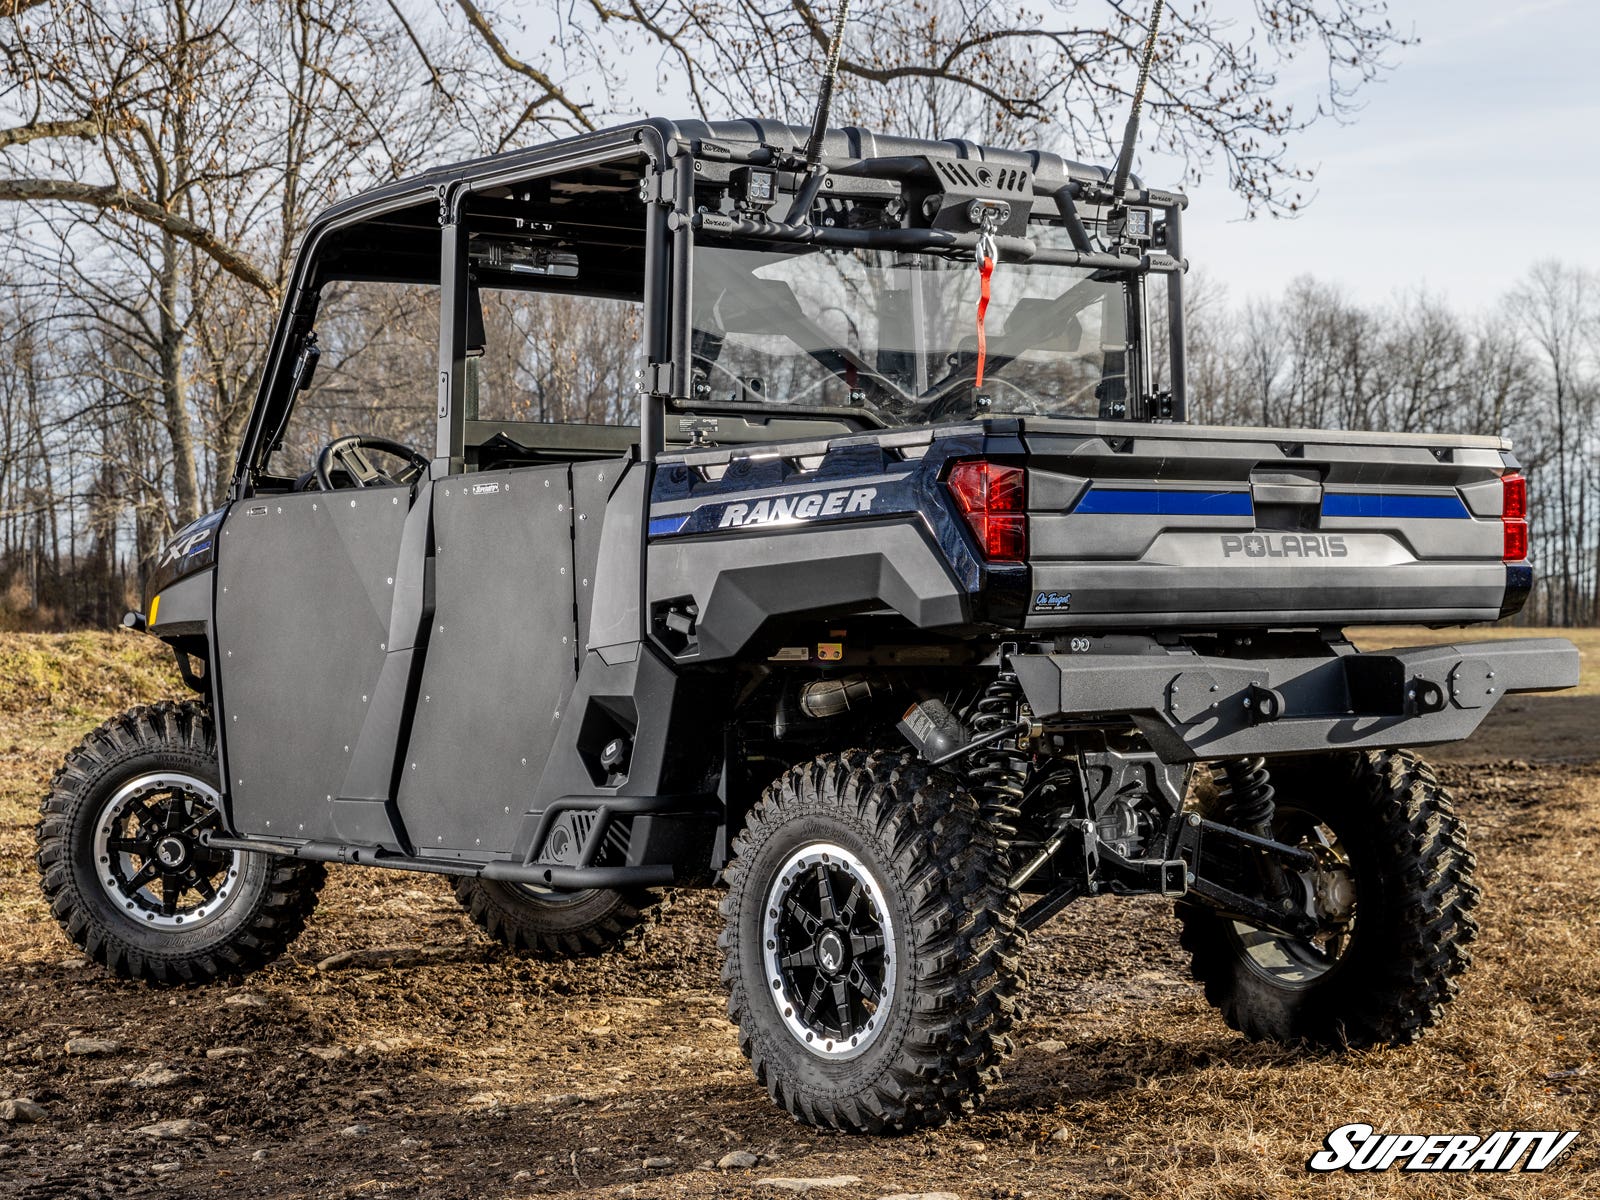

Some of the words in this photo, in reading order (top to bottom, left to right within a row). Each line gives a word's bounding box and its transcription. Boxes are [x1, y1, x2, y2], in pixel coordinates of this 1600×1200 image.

[718, 487, 877, 528] RANGER
[160, 529, 210, 569] XP
[1220, 535, 1348, 558] POLARIS
